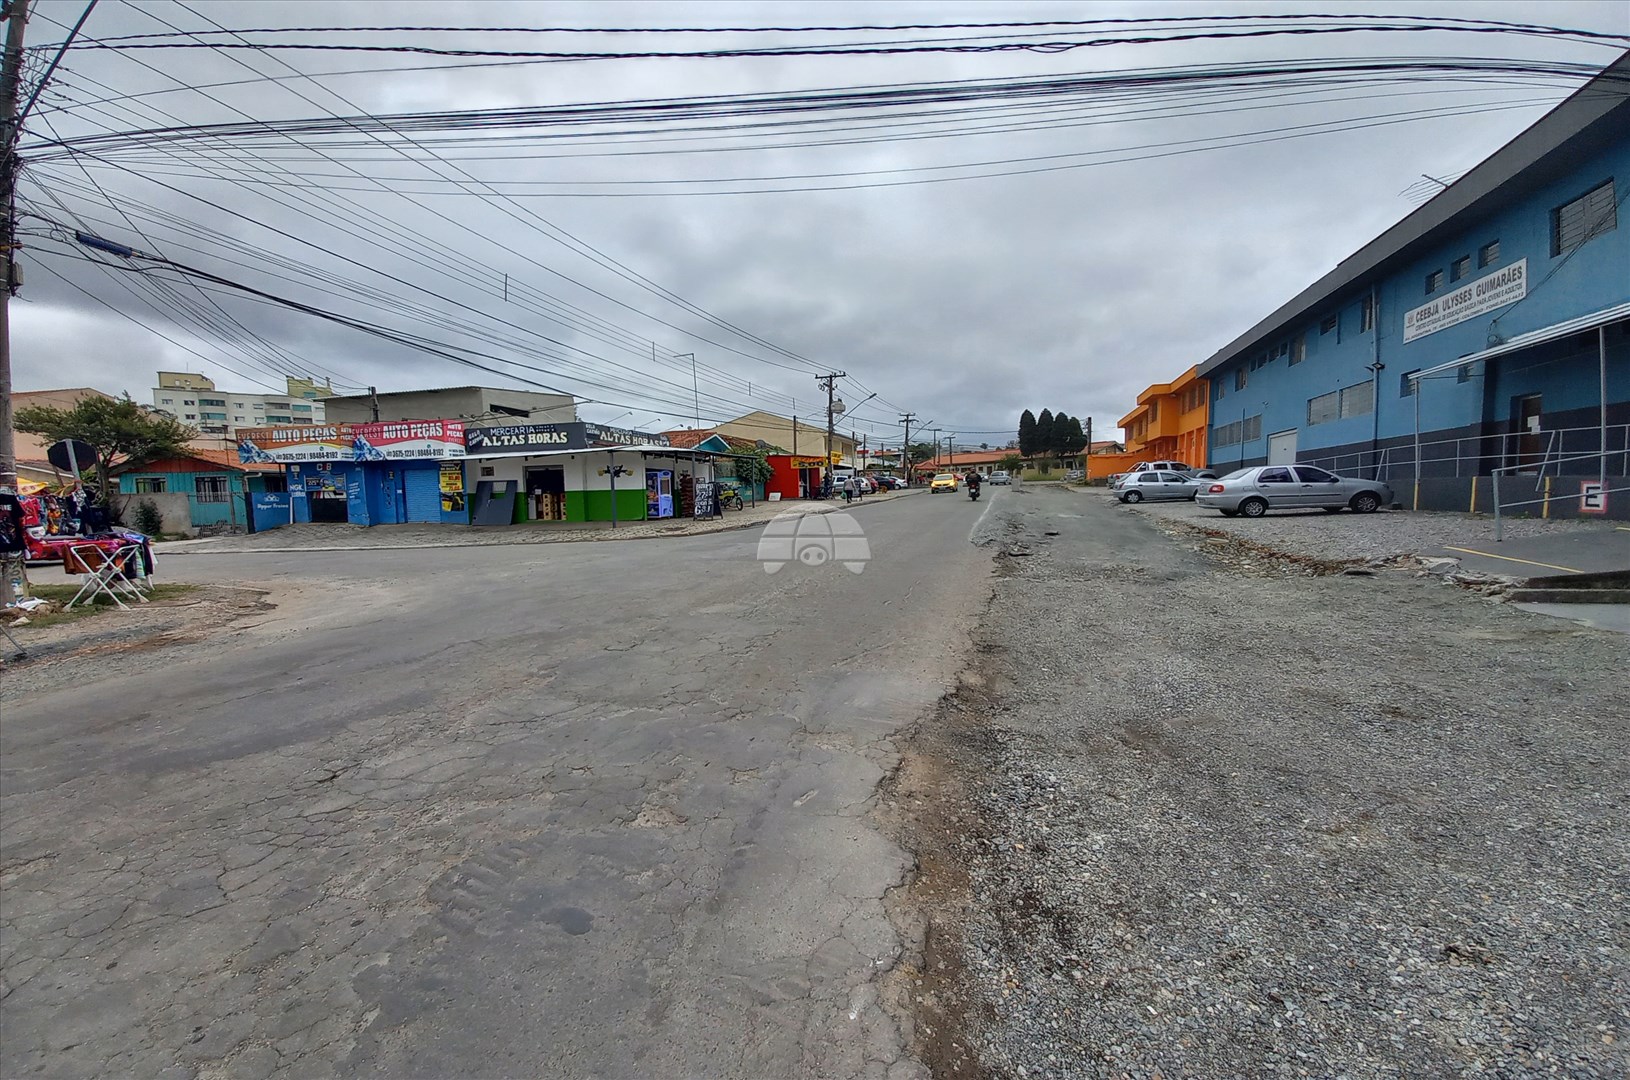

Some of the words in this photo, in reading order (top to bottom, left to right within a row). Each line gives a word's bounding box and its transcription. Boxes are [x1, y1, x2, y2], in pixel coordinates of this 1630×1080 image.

[1415, 303, 1439, 323] CEEBJA
[1442, 288, 1472, 312] ULYSSES
[1476, 265, 1522, 297] GUIMARÃES
[272, 429, 300, 442] AUTO
[303, 427, 337, 444] PEÇAS
[383, 424, 408, 439] AUTO
[411, 422, 442, 439] PEÇAS
[482, 434, 525, 447] ALTAS
[528, 431, 568, 444] HORAS
[490, 426, 535, 436] MERCEARIA
[600, 431, 631, 445] ALTAS
[632, 436, 659, 447] HORAS
[1585, 486, 1600, 507] E
